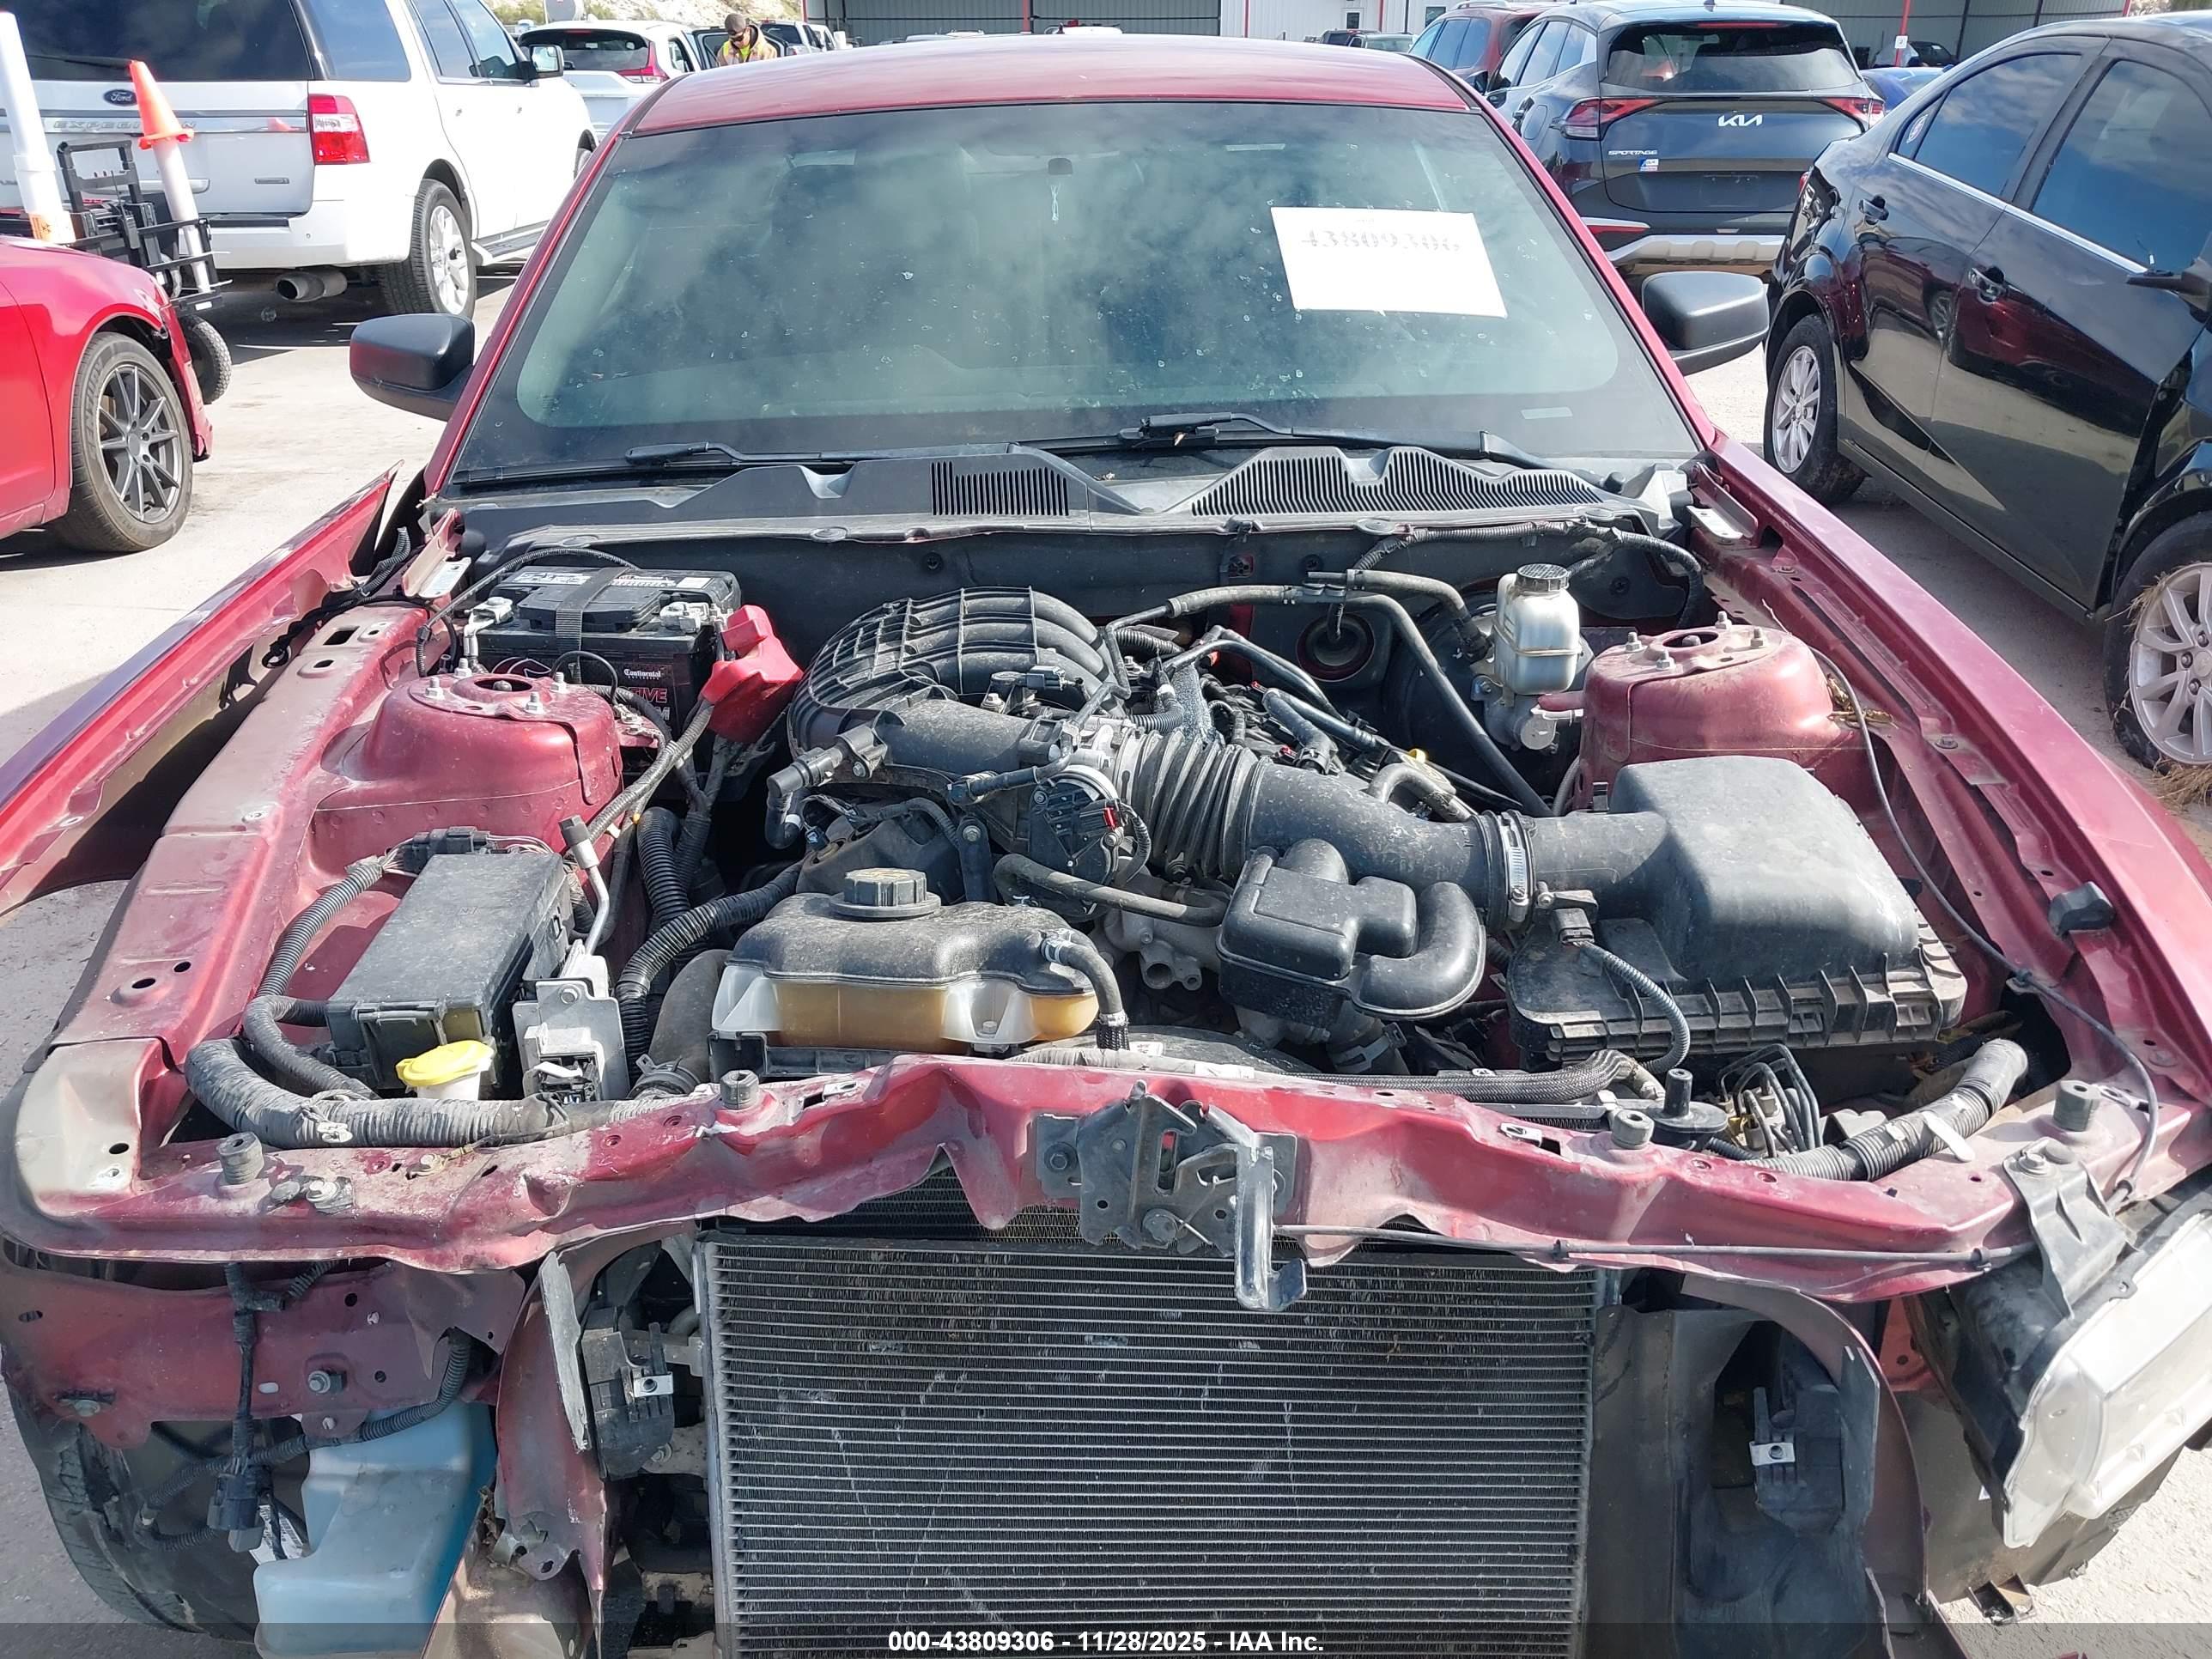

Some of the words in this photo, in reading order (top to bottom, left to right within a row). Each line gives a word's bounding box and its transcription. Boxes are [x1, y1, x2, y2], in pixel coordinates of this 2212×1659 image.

[110, 92, 132, 101] Ford
[53, 120, 196, 130] EXPEDIN
[1718, 114, 1763, 127] KIA
[623, 668, 661, 678] Continental
